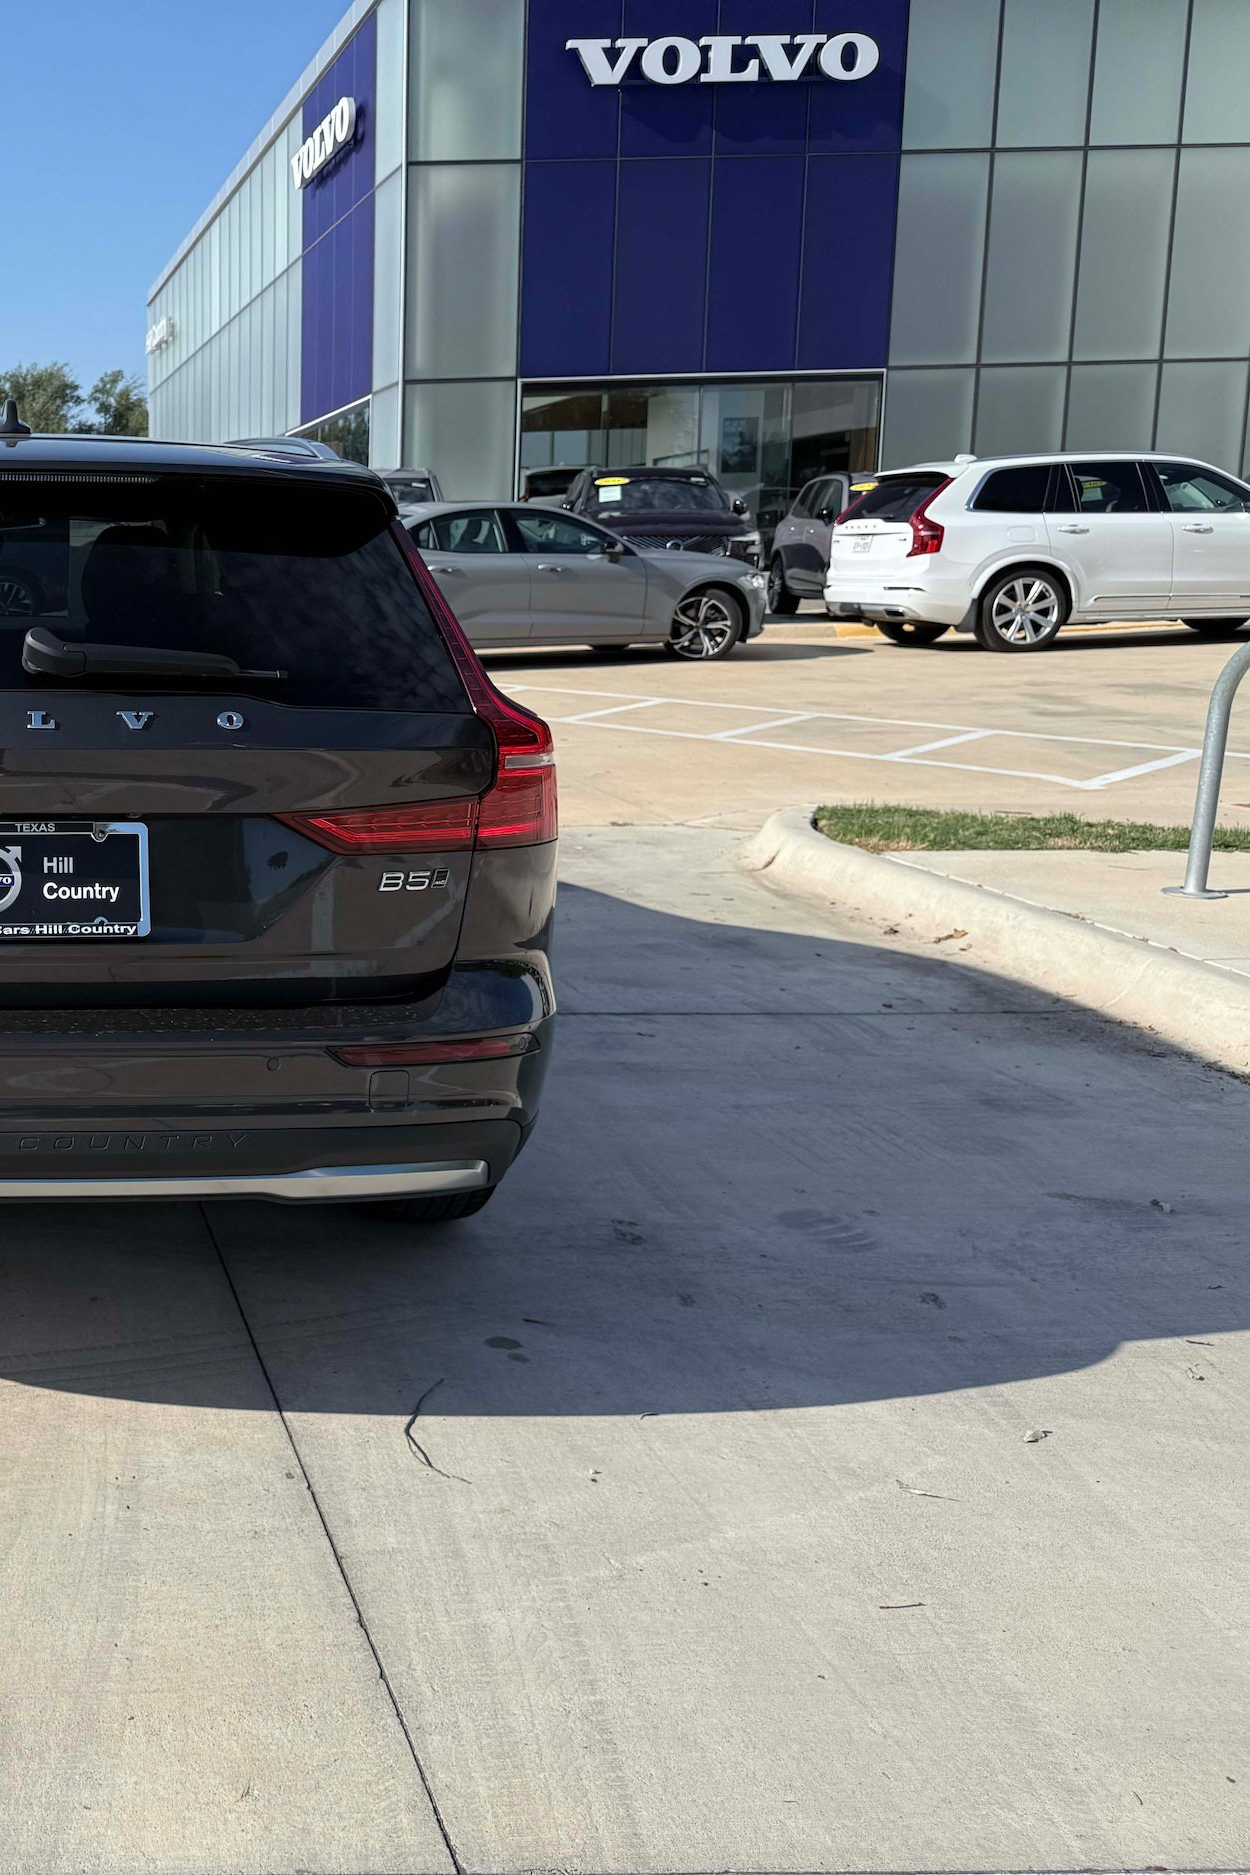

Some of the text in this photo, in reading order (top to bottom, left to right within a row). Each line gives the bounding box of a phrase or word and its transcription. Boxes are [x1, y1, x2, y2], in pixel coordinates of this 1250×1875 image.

[565, 32, 880, 86] VOLVO
[290, 96, 356, 191] VOLVO
[14, 822, 56, 833] TEXAS
[42, 856, 75, 874] Hill
[378, 870, 431, 892] B5
[42, 882, 120, 903] Country
[34, 924, 64, 935] Hill
[67, 923, 138, 936] Country
[18, 1134, 248, 1151] COUNTRY
